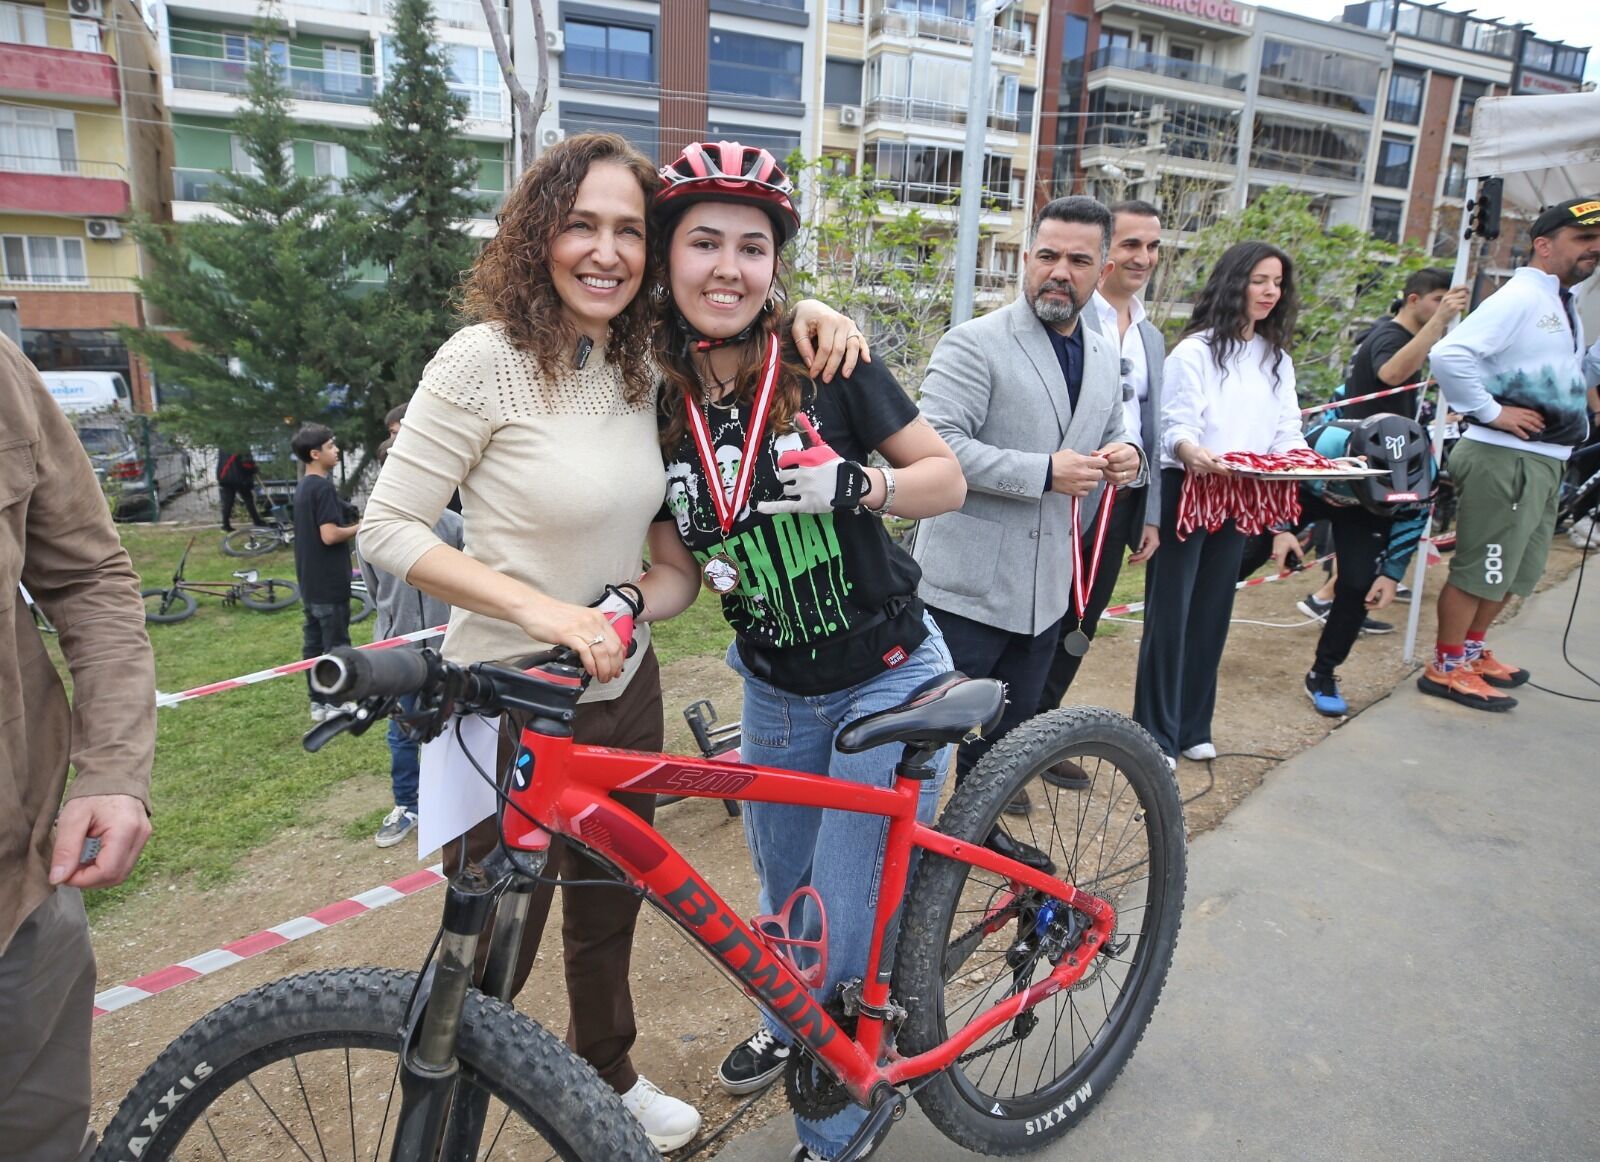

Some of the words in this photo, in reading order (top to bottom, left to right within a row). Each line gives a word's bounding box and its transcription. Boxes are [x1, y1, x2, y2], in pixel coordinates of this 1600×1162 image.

[1484, 543, 1503, 585] POC
[118, 1061, 213, 1162] AXXIS
[1025, 1081, 1093, 1136] MAXXIS
